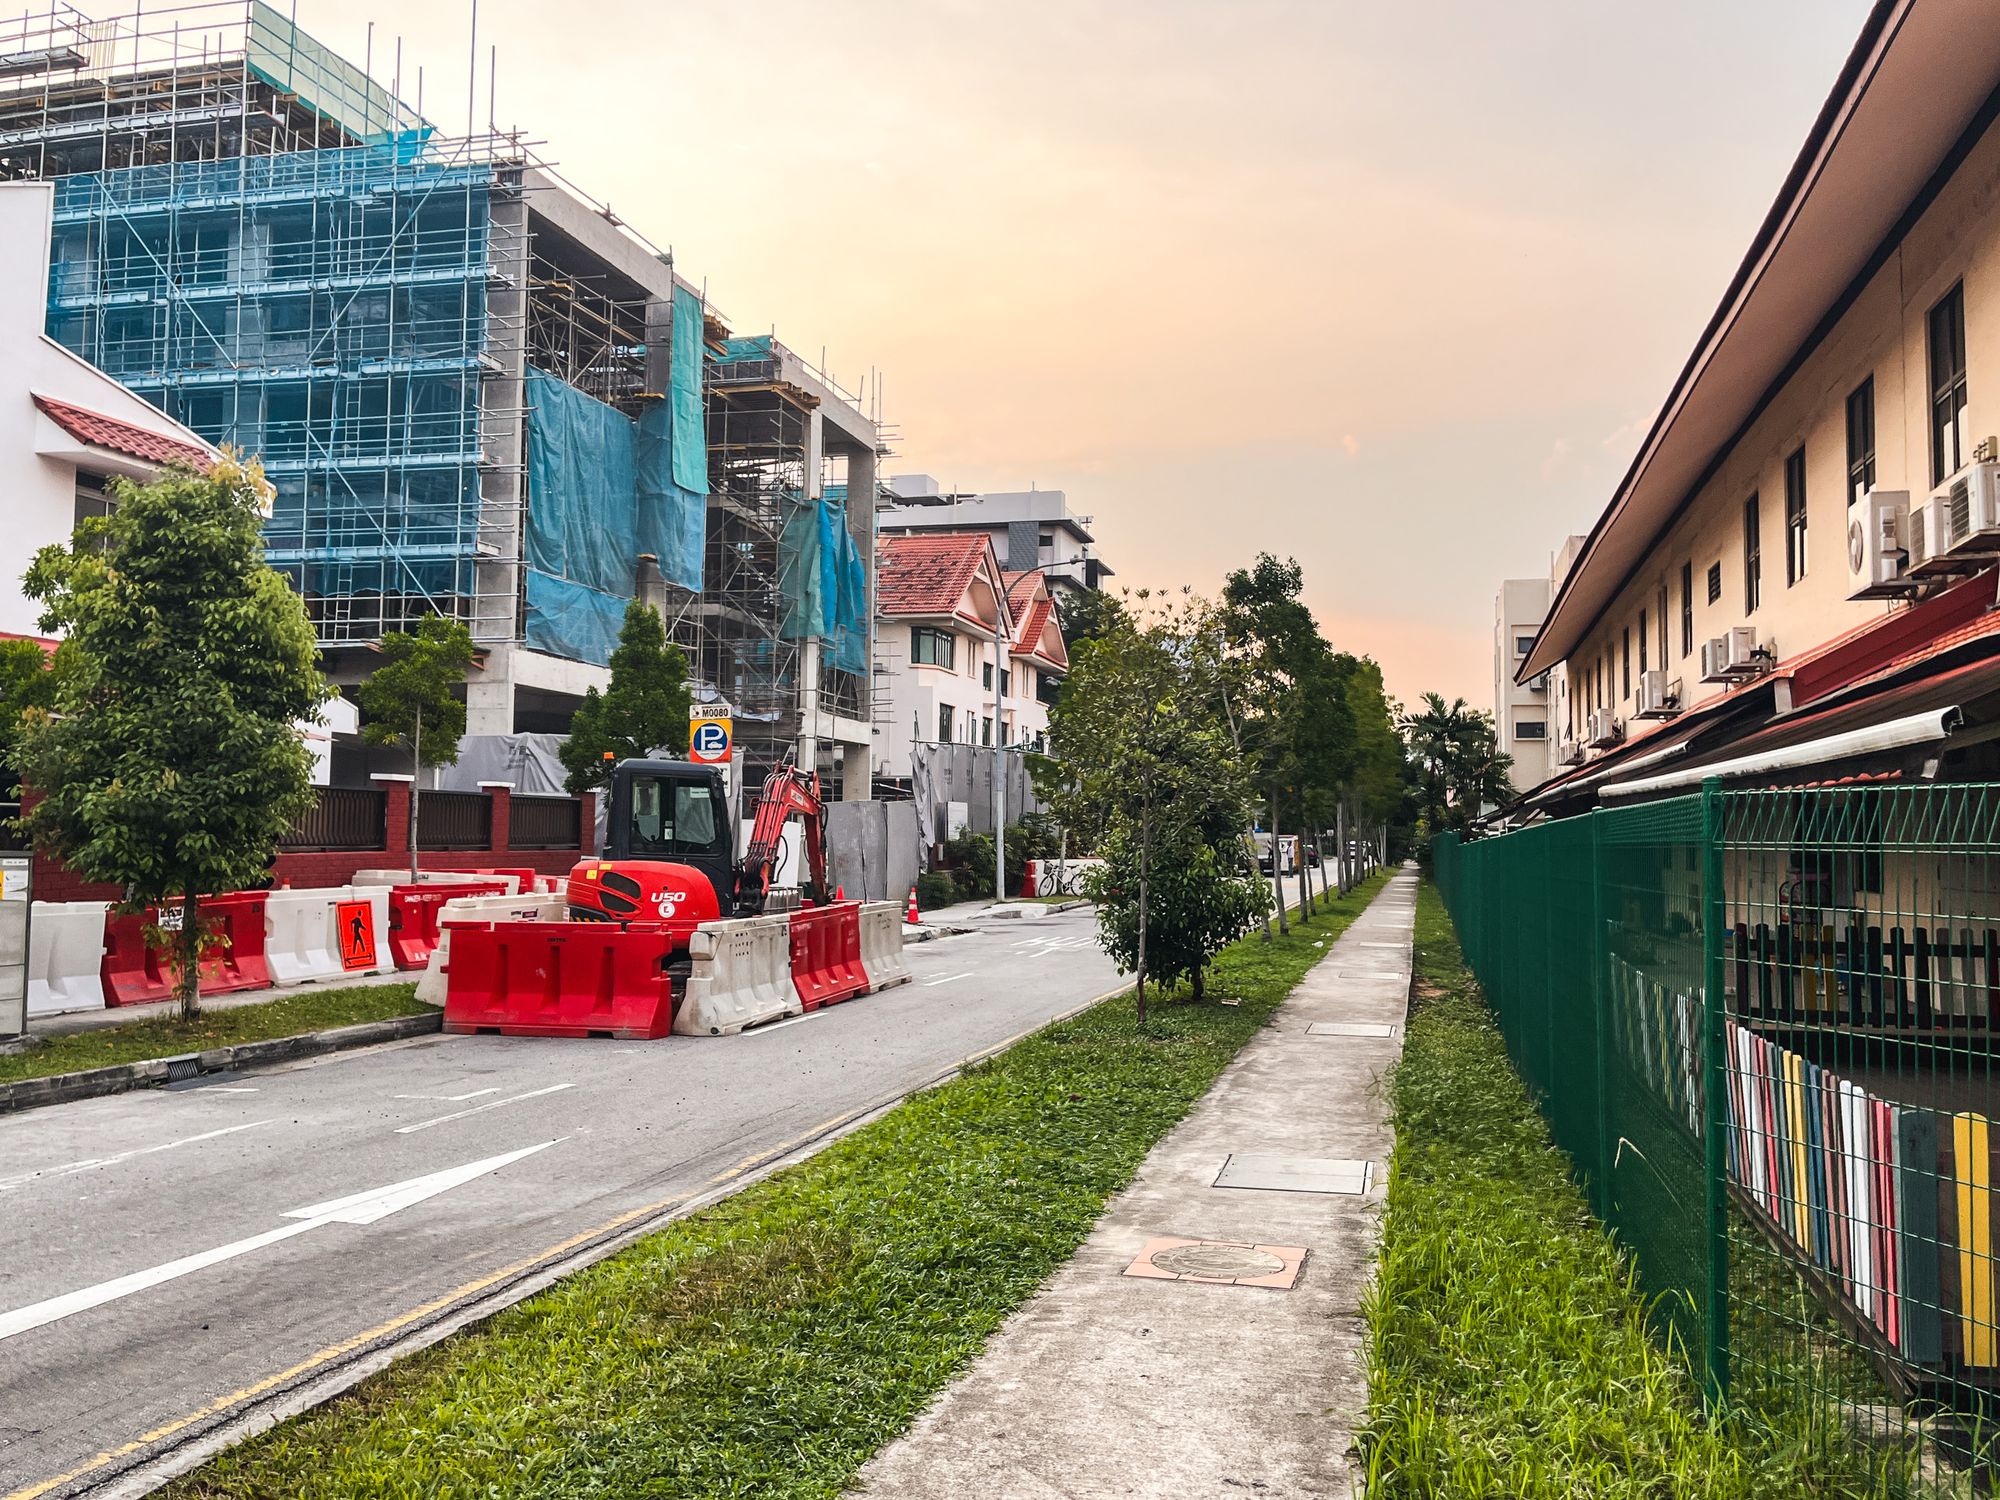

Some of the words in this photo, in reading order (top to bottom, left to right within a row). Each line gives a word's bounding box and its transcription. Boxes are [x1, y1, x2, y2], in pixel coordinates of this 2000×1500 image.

[702, 708, 729, 718] M0080
[700, 726, 725, 751] P
[651, 891, 686, 903] U50
